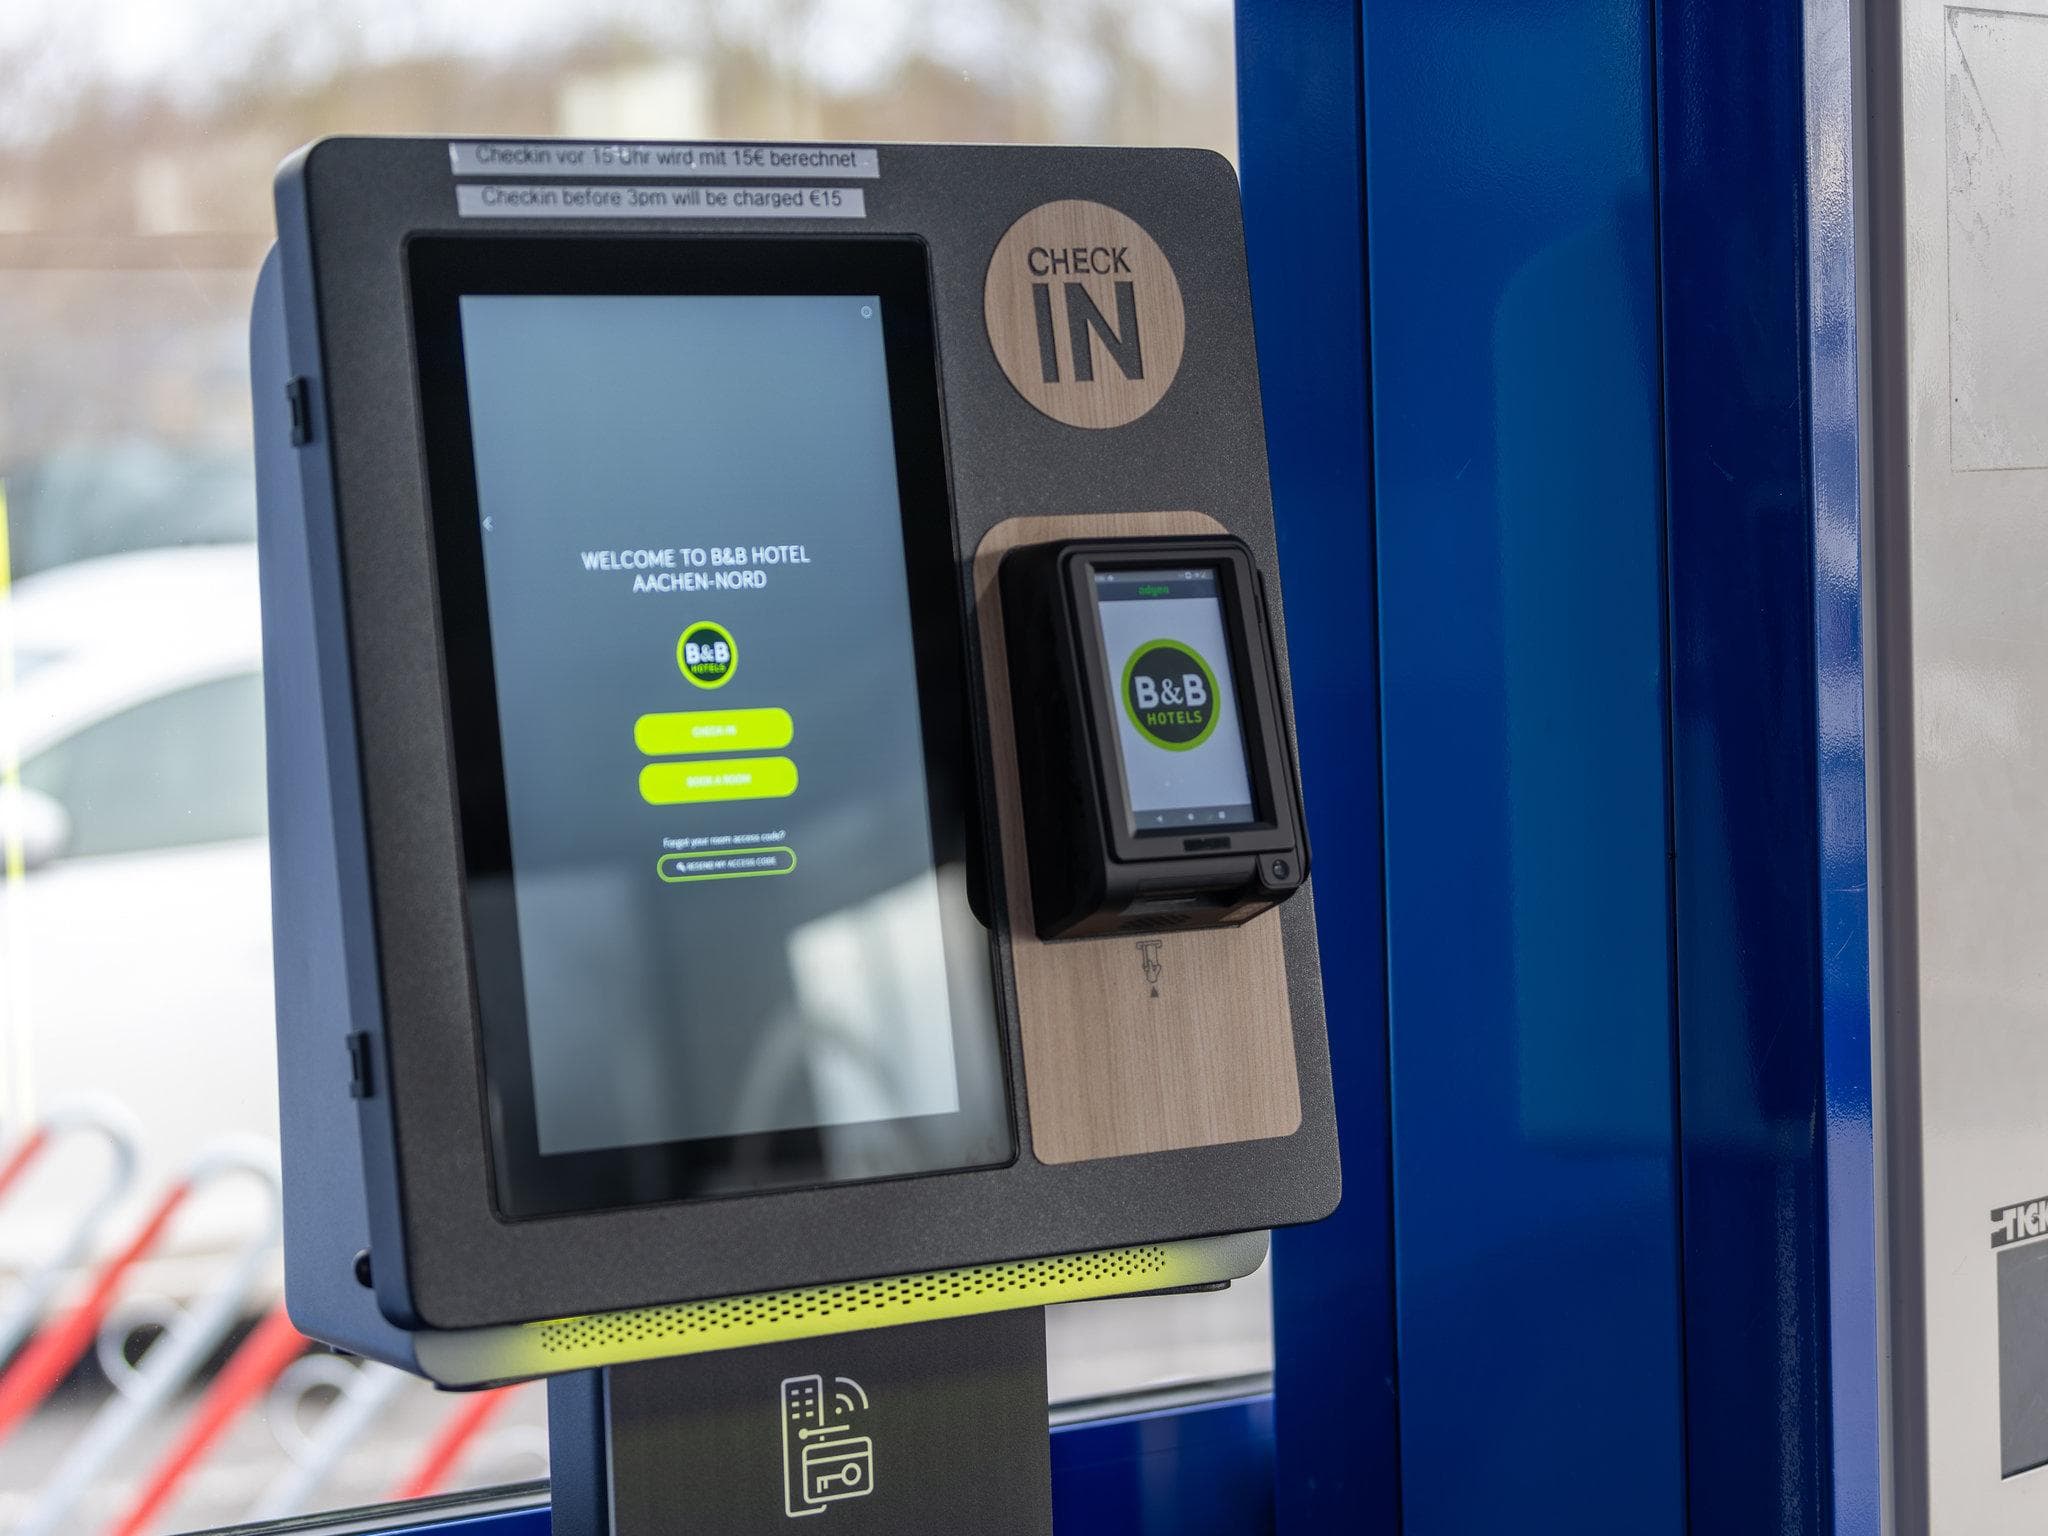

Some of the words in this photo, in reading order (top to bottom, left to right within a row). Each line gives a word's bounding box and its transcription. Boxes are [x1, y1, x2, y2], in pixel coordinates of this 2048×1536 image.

[475, 143, 550, 165] Checkin
[556, 150, 583, 166] vor
[593, 147, 612, 166] 15
[617, 146, 650, 166] Uhr
[656, 147, 692, 166] wird
[700, 148, 727, 166] mit
[734, 149, 765, 167] 15€
[769, 149, 857, 168] berechnet
[481, 186, 556, 207] Checkin
[562, 187, 621, 207] before
[627, 188, 667, 209] 3pm
[672, 187, 700, 206] will
[705, 189, 728, 207] be
[733, 189, 804, 210] charged
[809, 189, 842, 207] €15
[1028, 247, 1131, 276] CHECK
[1031, 281, 1145, 383] IN
[581, 549, 676, 571] WELCOME
[680, 549, 706, 567] TO
[710, 547, 748, 566] B&B
[752, 545, 811, 564] HOTEL
[632, 570, 767, 593] AACHEN-NORD
[685, 642, 730, 664] B&B
[1134, 674, 1206, 709] B&B
[1147, 710, 1202, 725] HOTELS
[663, 837, 690, 850] Forgot
[691, 837, 709, 849] your
